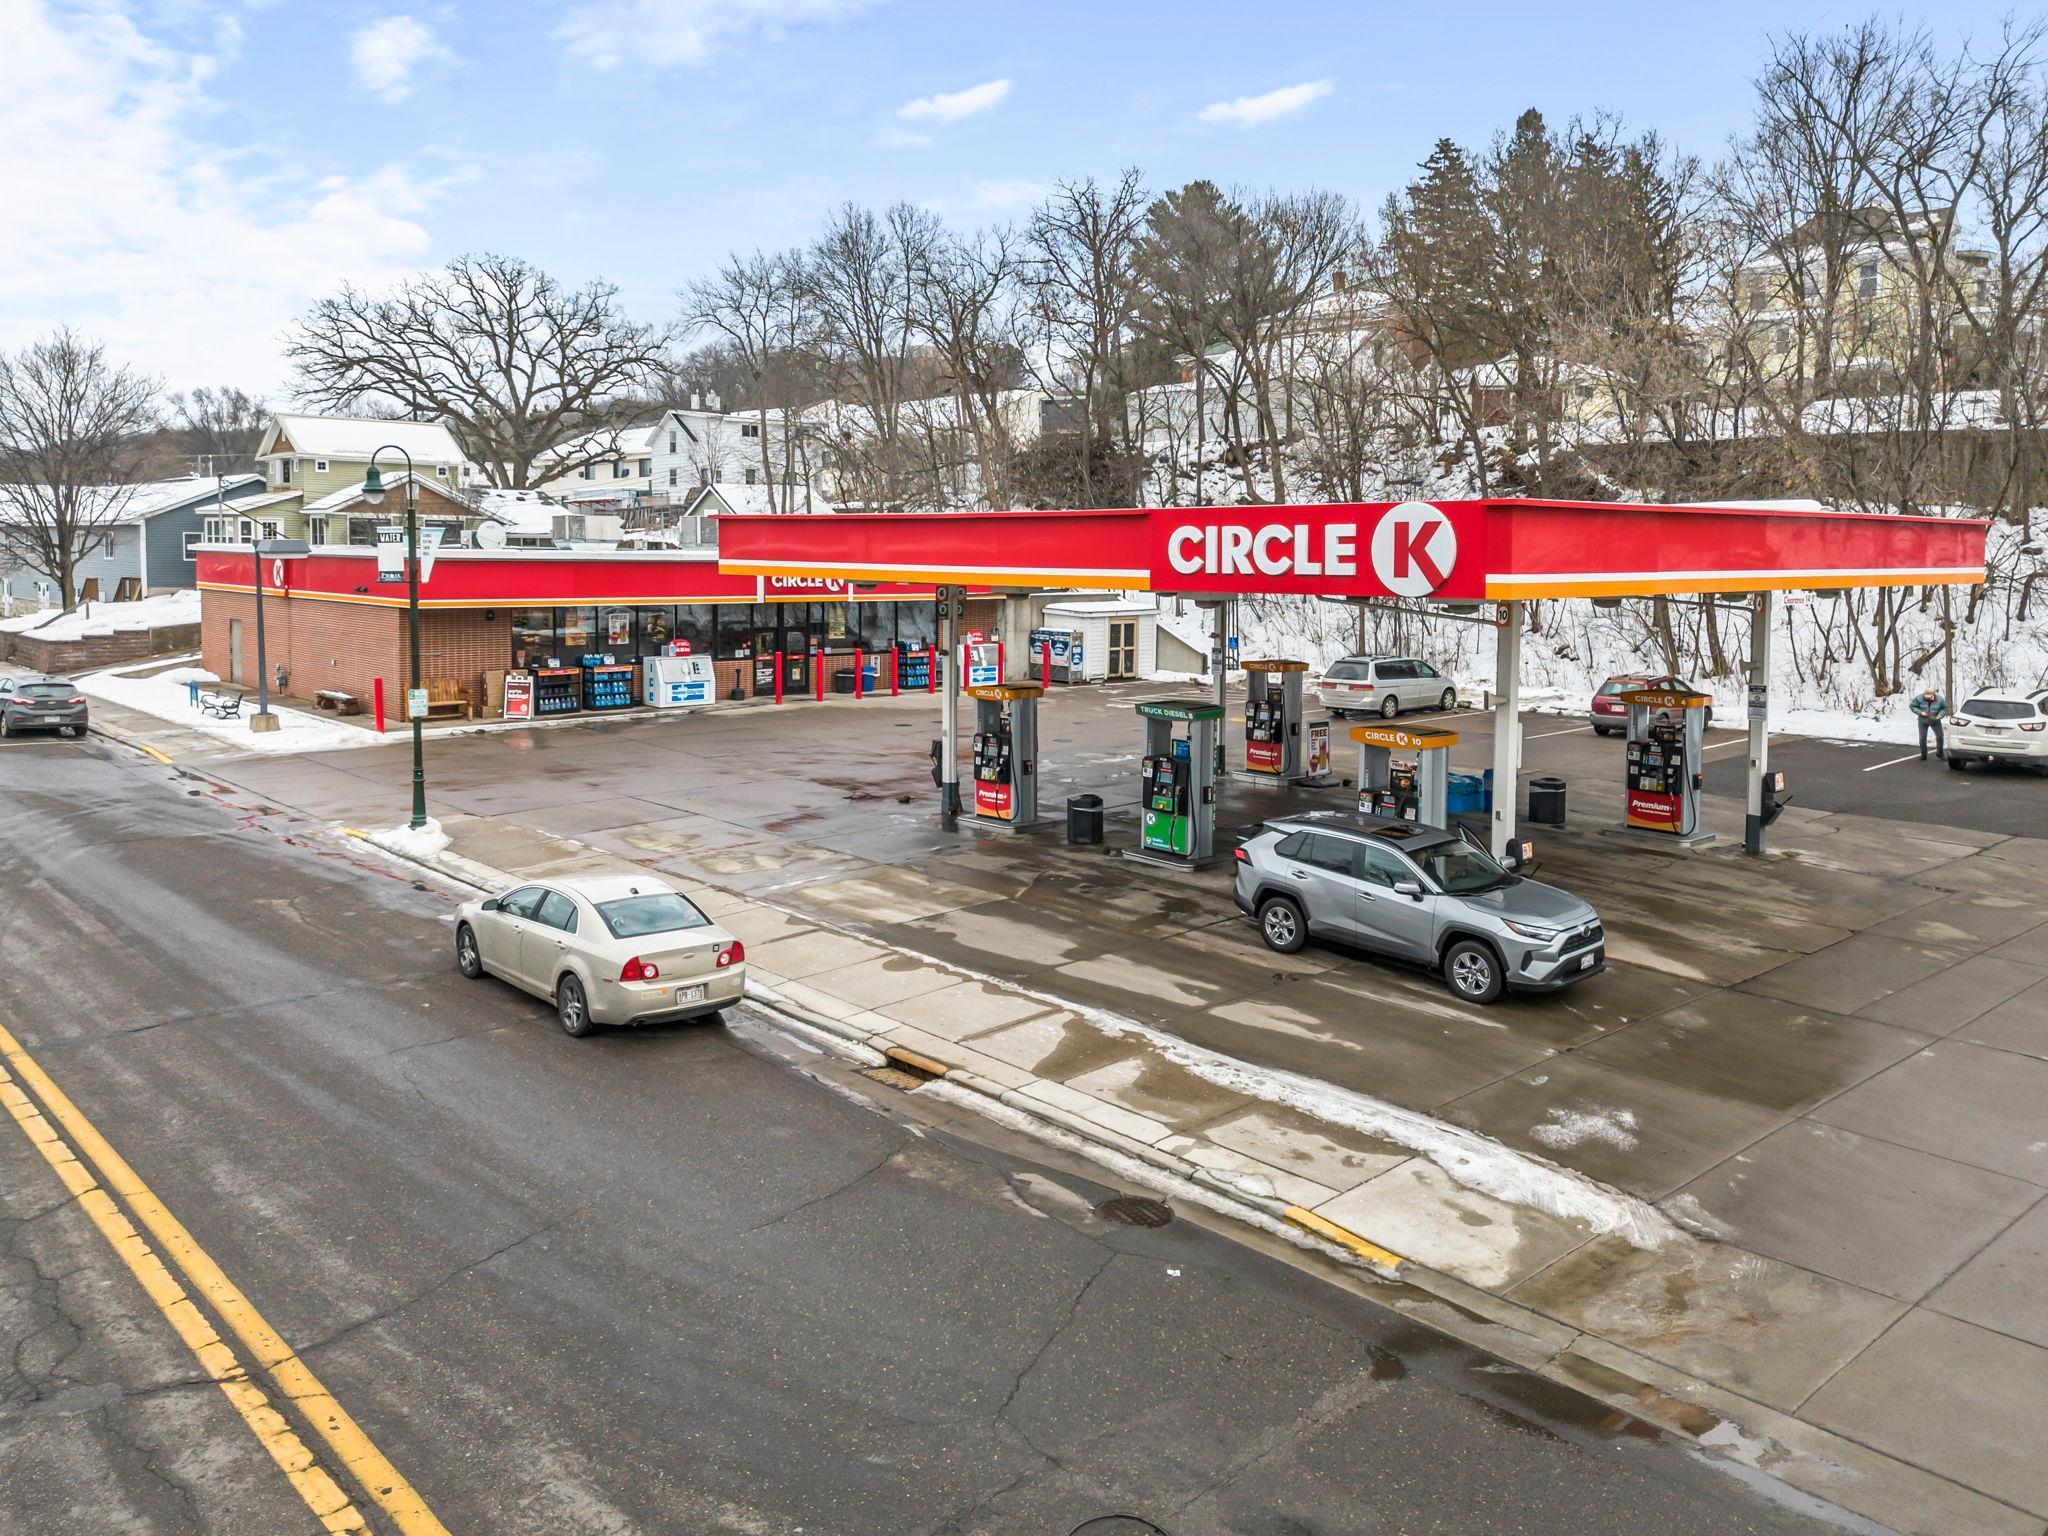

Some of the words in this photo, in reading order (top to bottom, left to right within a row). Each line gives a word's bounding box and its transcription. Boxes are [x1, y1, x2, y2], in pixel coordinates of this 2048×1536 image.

[379, 533, 401, 542] WATER
[1168, 523, 1357, 576] CIRCLE
[1392, 519, 1449, 592] K
[771, 575, 824, 588] CIRCLE
[1499, 609, 1508, 621] 10
[975, 689, 995, 697] CIRCLE
[1634, 695, 1663, 704] CIRCLE
[1140, 705, 1163, 716] TRUCK
[1164, 709, 1189, 719] DIESEL
[1310, 729, 1328, 738] FREE
[1365, 731, 1395, 742] CIRCLE
[1397, 733, 1408, 745] K
[1411, 738, 1422, 746] 10
